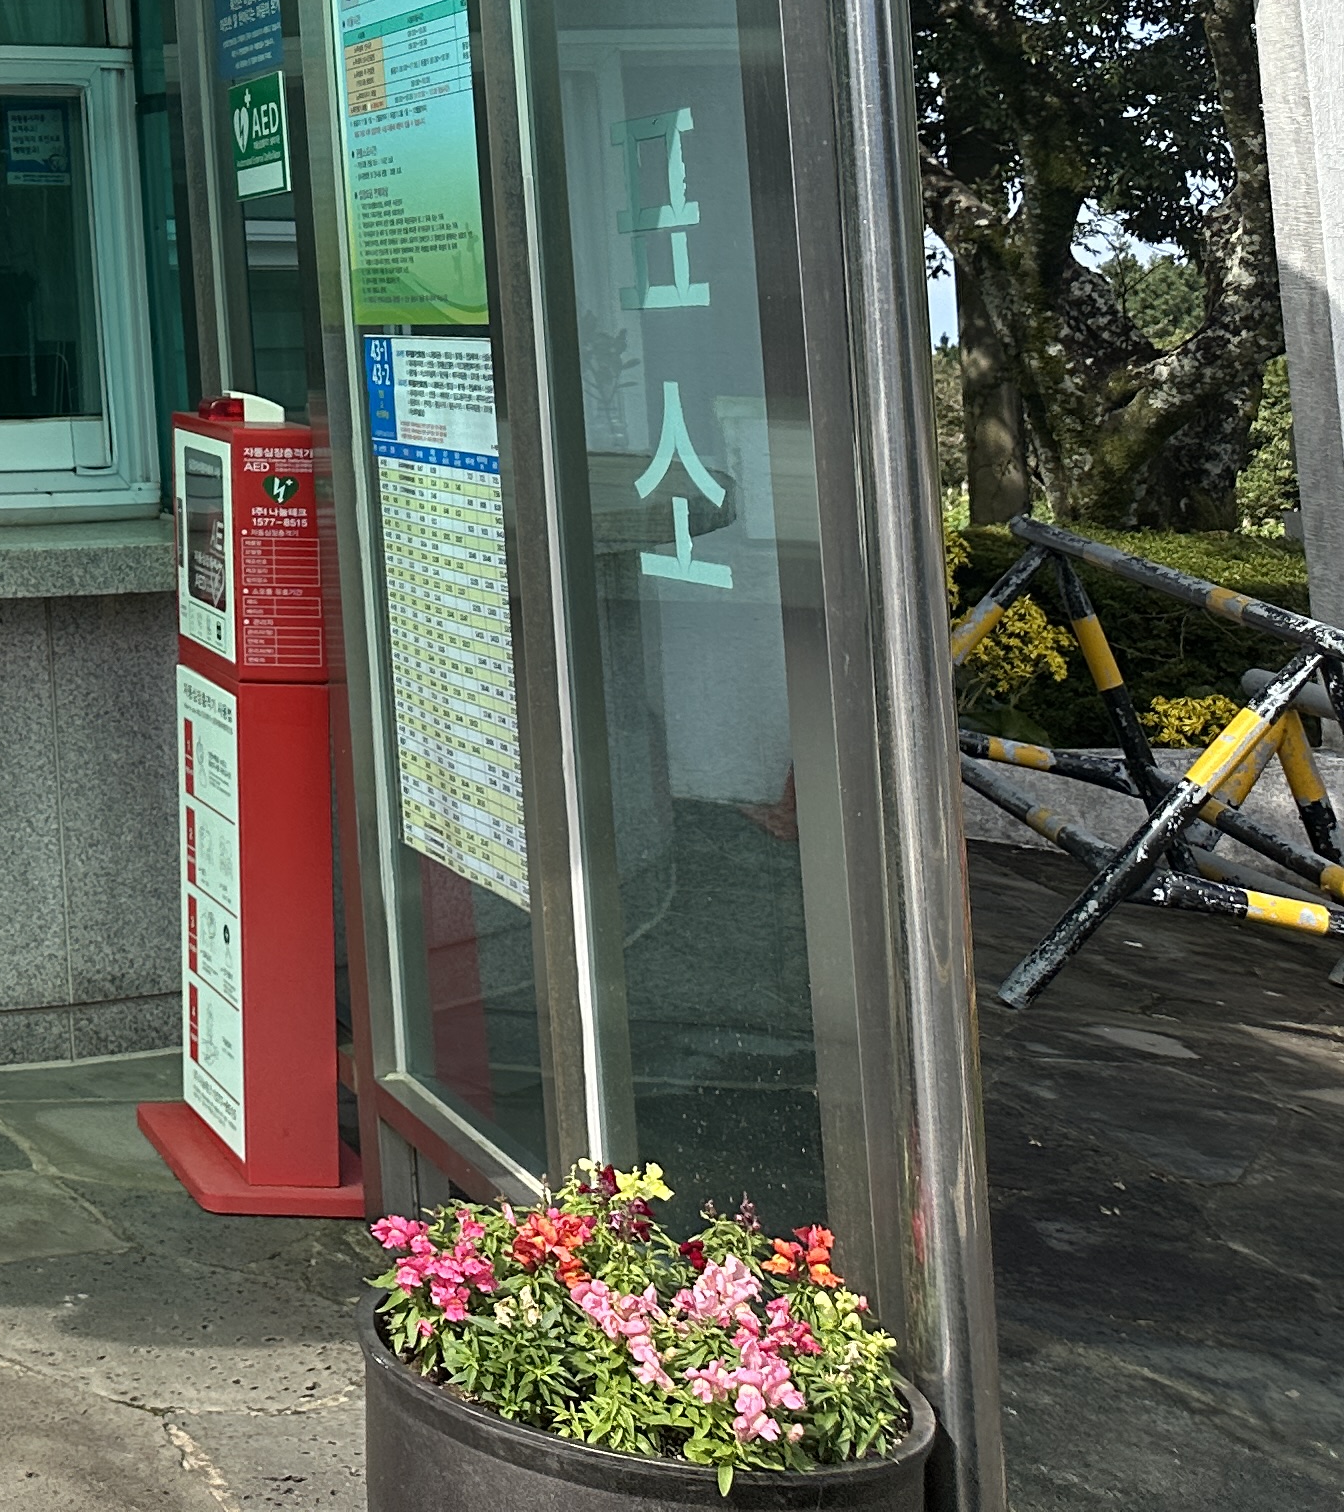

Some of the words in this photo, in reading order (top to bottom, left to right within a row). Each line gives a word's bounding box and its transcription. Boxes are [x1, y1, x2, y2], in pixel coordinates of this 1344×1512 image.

[252, 102, 279, 138] AED
[370, 339, 388, 362] 43-1
[372, 363, 391, 386] 43-2
[243, 462, 270, 472] AED
[251, 518, 308, 528] 1577-8515
